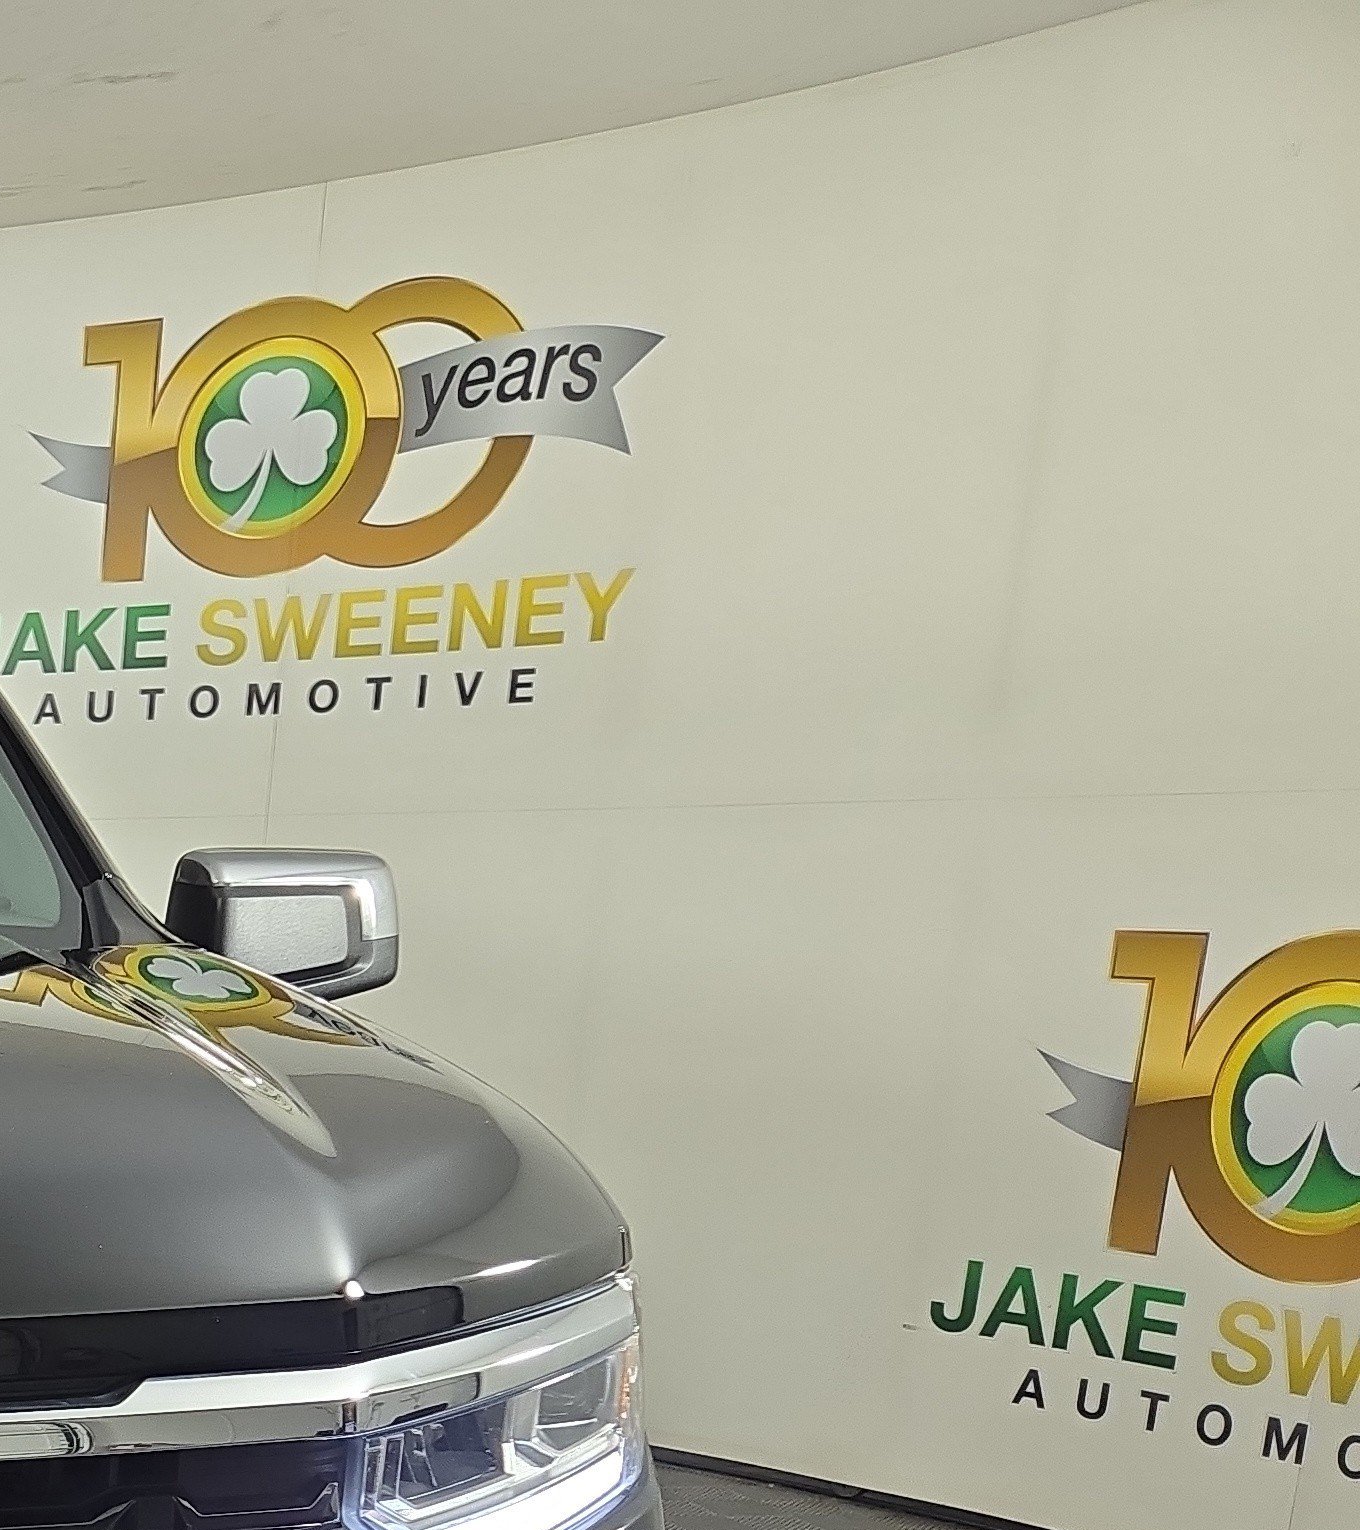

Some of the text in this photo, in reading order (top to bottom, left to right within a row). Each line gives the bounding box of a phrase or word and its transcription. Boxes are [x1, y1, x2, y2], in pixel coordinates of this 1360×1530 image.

[414, 340, 602, 438] years
[195, 567, 635, 667] SWEENEY
[34, 667, 537, 726] AUTOMOTIVE
[930, 1260, 1187, 1370] JAKE
